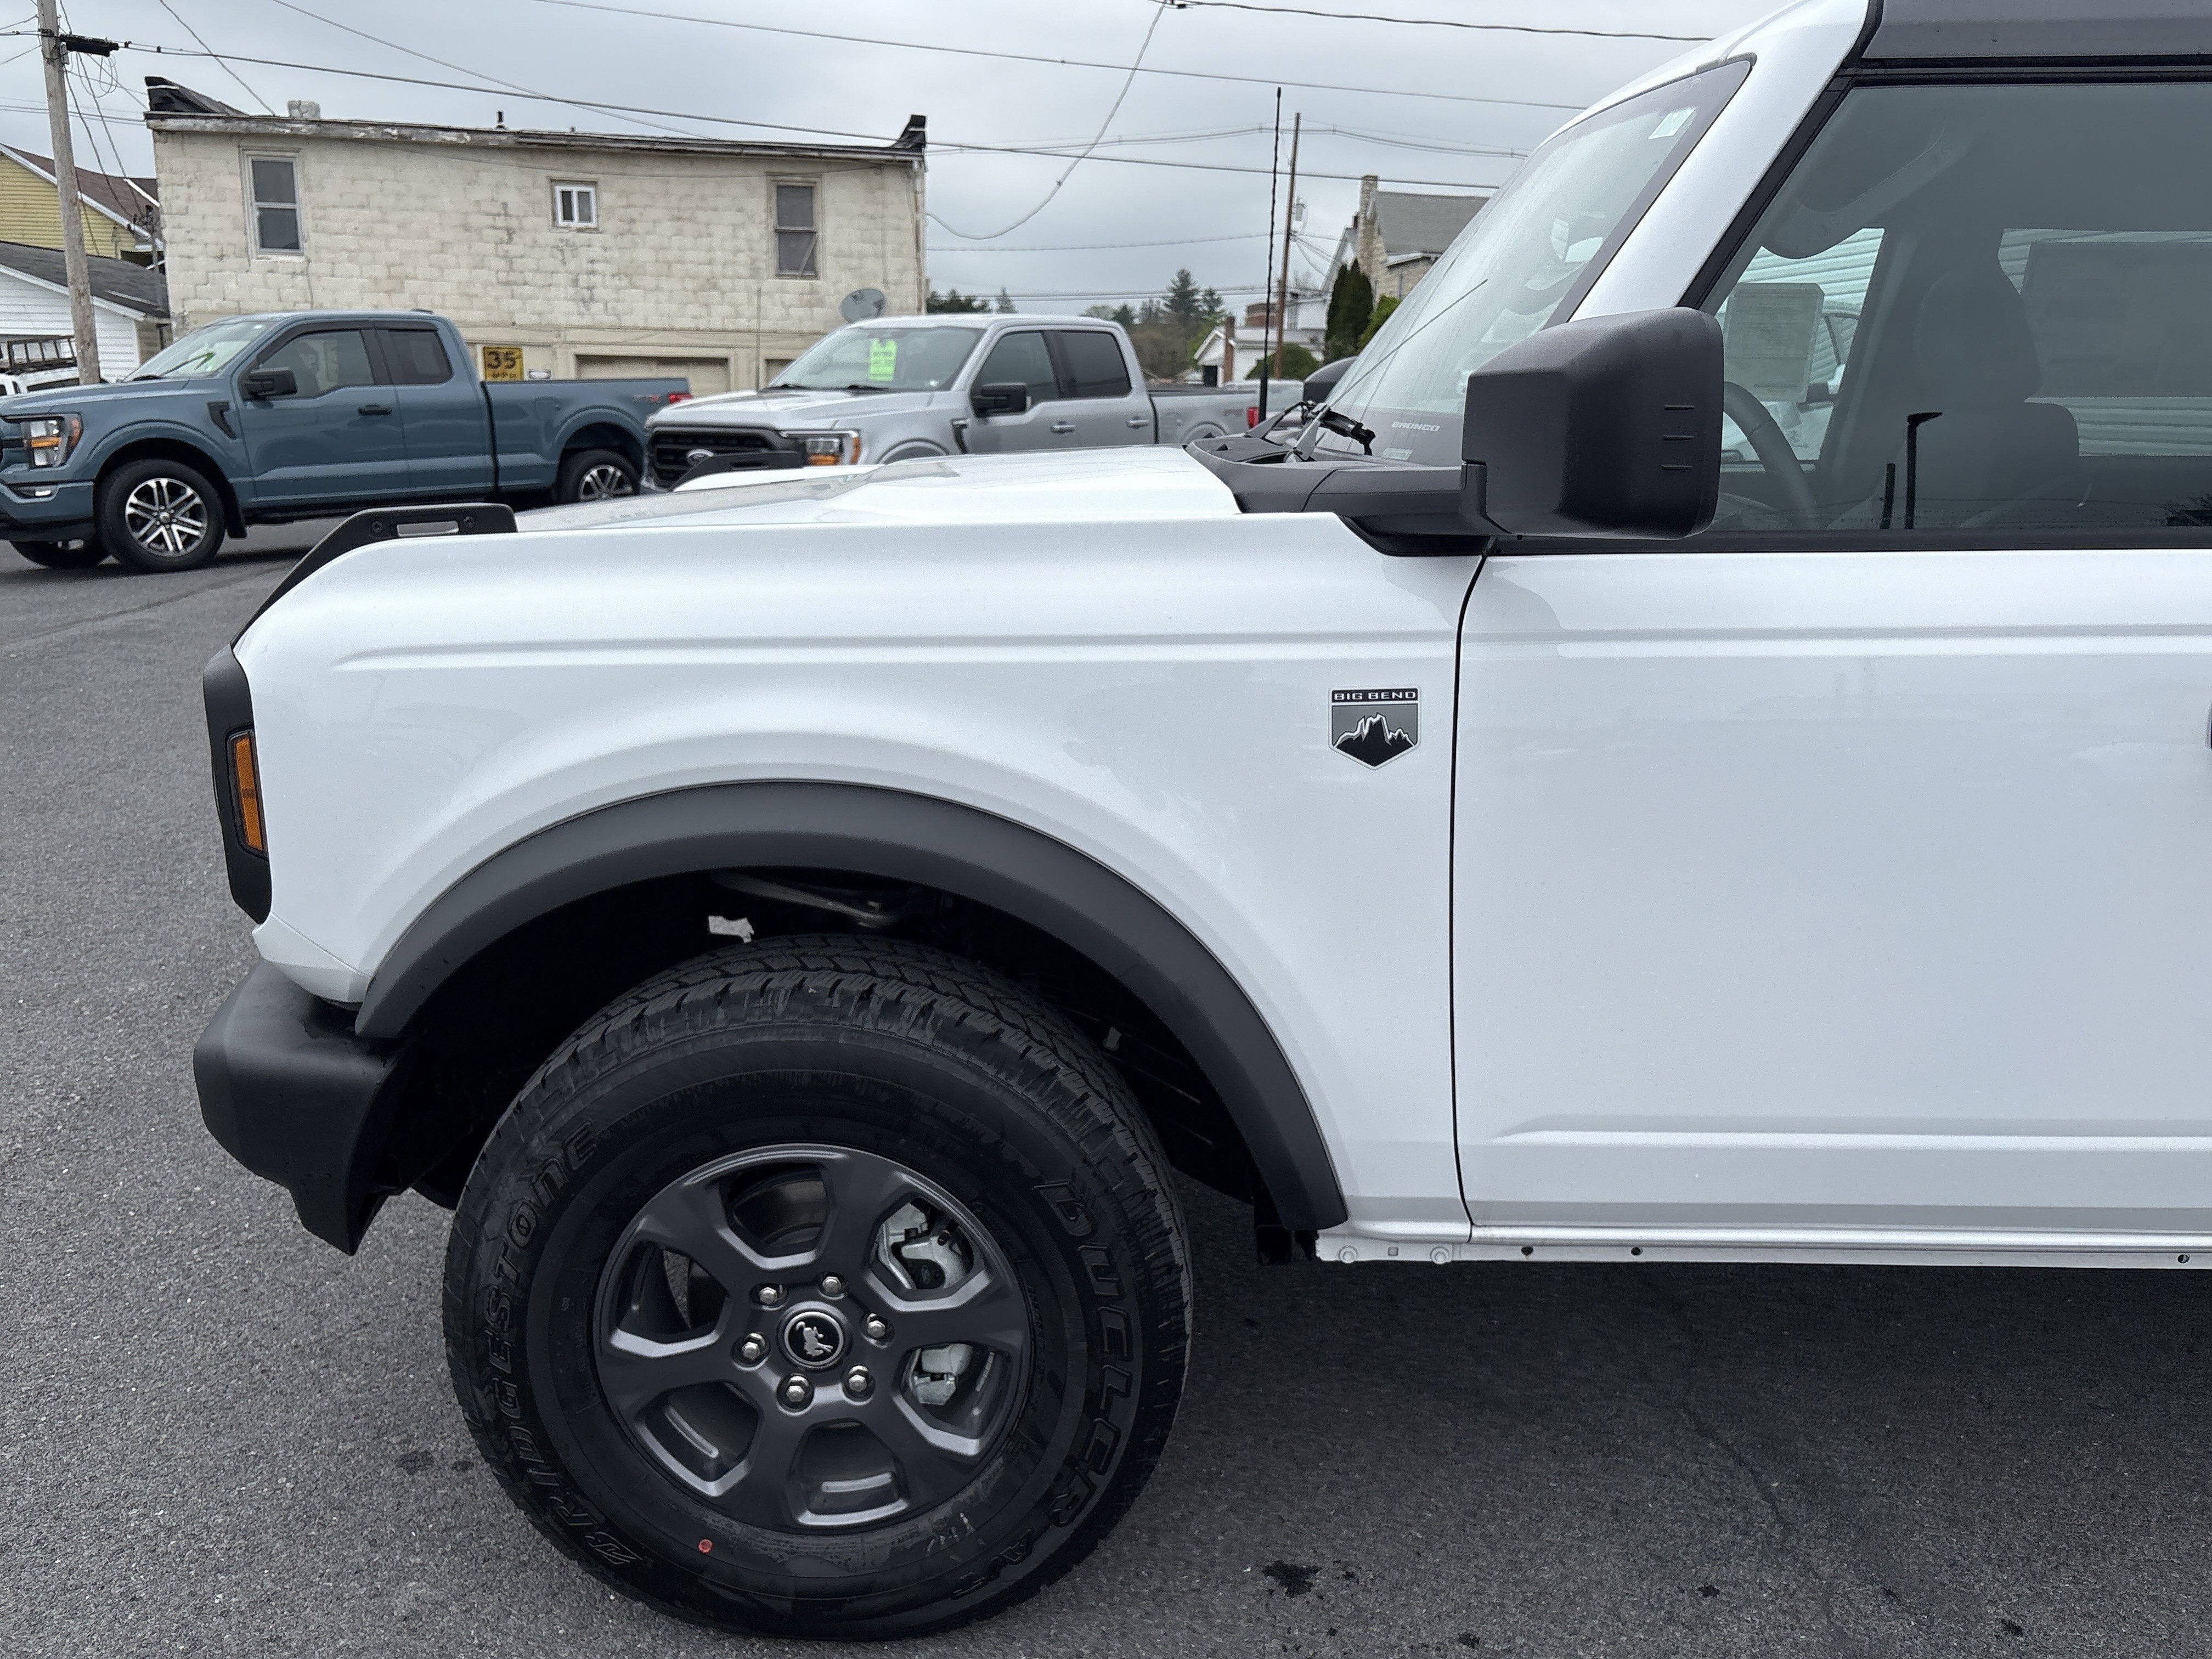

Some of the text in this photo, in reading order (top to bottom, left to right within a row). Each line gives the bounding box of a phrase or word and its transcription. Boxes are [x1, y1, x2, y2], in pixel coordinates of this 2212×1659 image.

[487, 351, 516, 369] 35
[1391, 422, 1441, 432] BRONCO
[1334, 691, 1417, 701] BIG BEND
[484, 1119, 644, 1566] BRIDGESTONE
